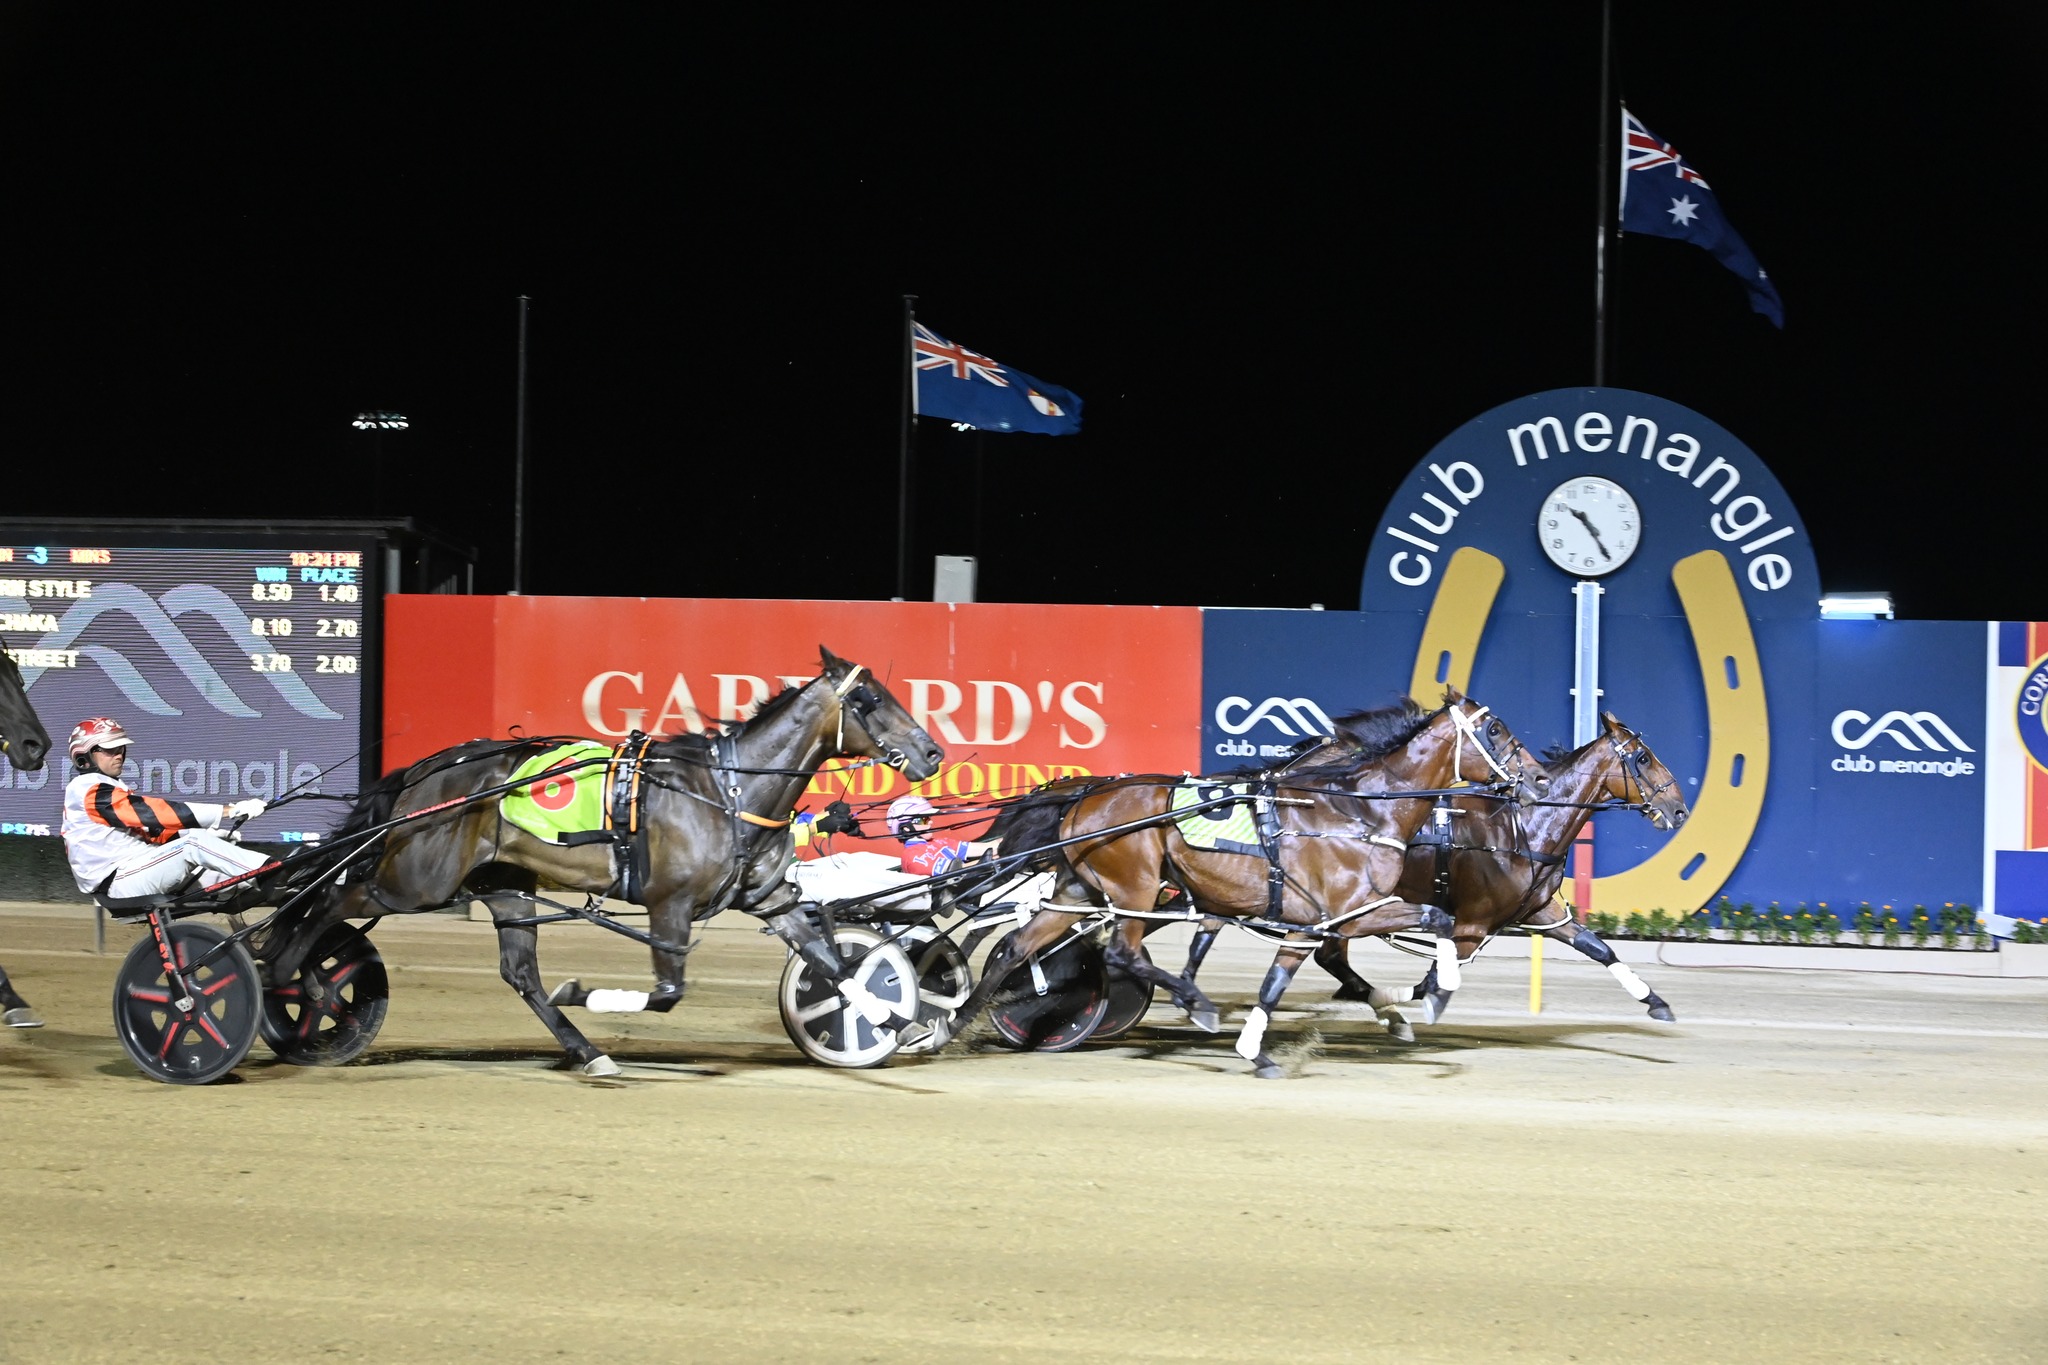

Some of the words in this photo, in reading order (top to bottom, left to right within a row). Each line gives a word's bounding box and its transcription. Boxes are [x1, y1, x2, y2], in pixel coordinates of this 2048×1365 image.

[1387, 460, 1485, 587] club
[1507, 411, 1796, 592] menangle
[69, 549, 111, 564] MINS
[333, 553, 361, 568] PM
[301, 568, 358, 584] PLACE
[28, 580, 92, 598] STYLE
[252, 584, 293, 602] 8.50
[319, 585, 358, 603] 1.40
[251, 618, 293, 637] 8.10
[316, 619, 358, 638] 2.70
[4, 649, 80, 668] STREET
[251, 654, 292, 672] 3.70
[316, 655, 358, 674] 2.00
[581, 669, 1108, 749] GARRD'S
[1215, 738, 1256, 757] club
[1831, 753, 1876, 773] club
[1878, 756, 1976, 778] menangle
[529, 755, 581, 812] 6
